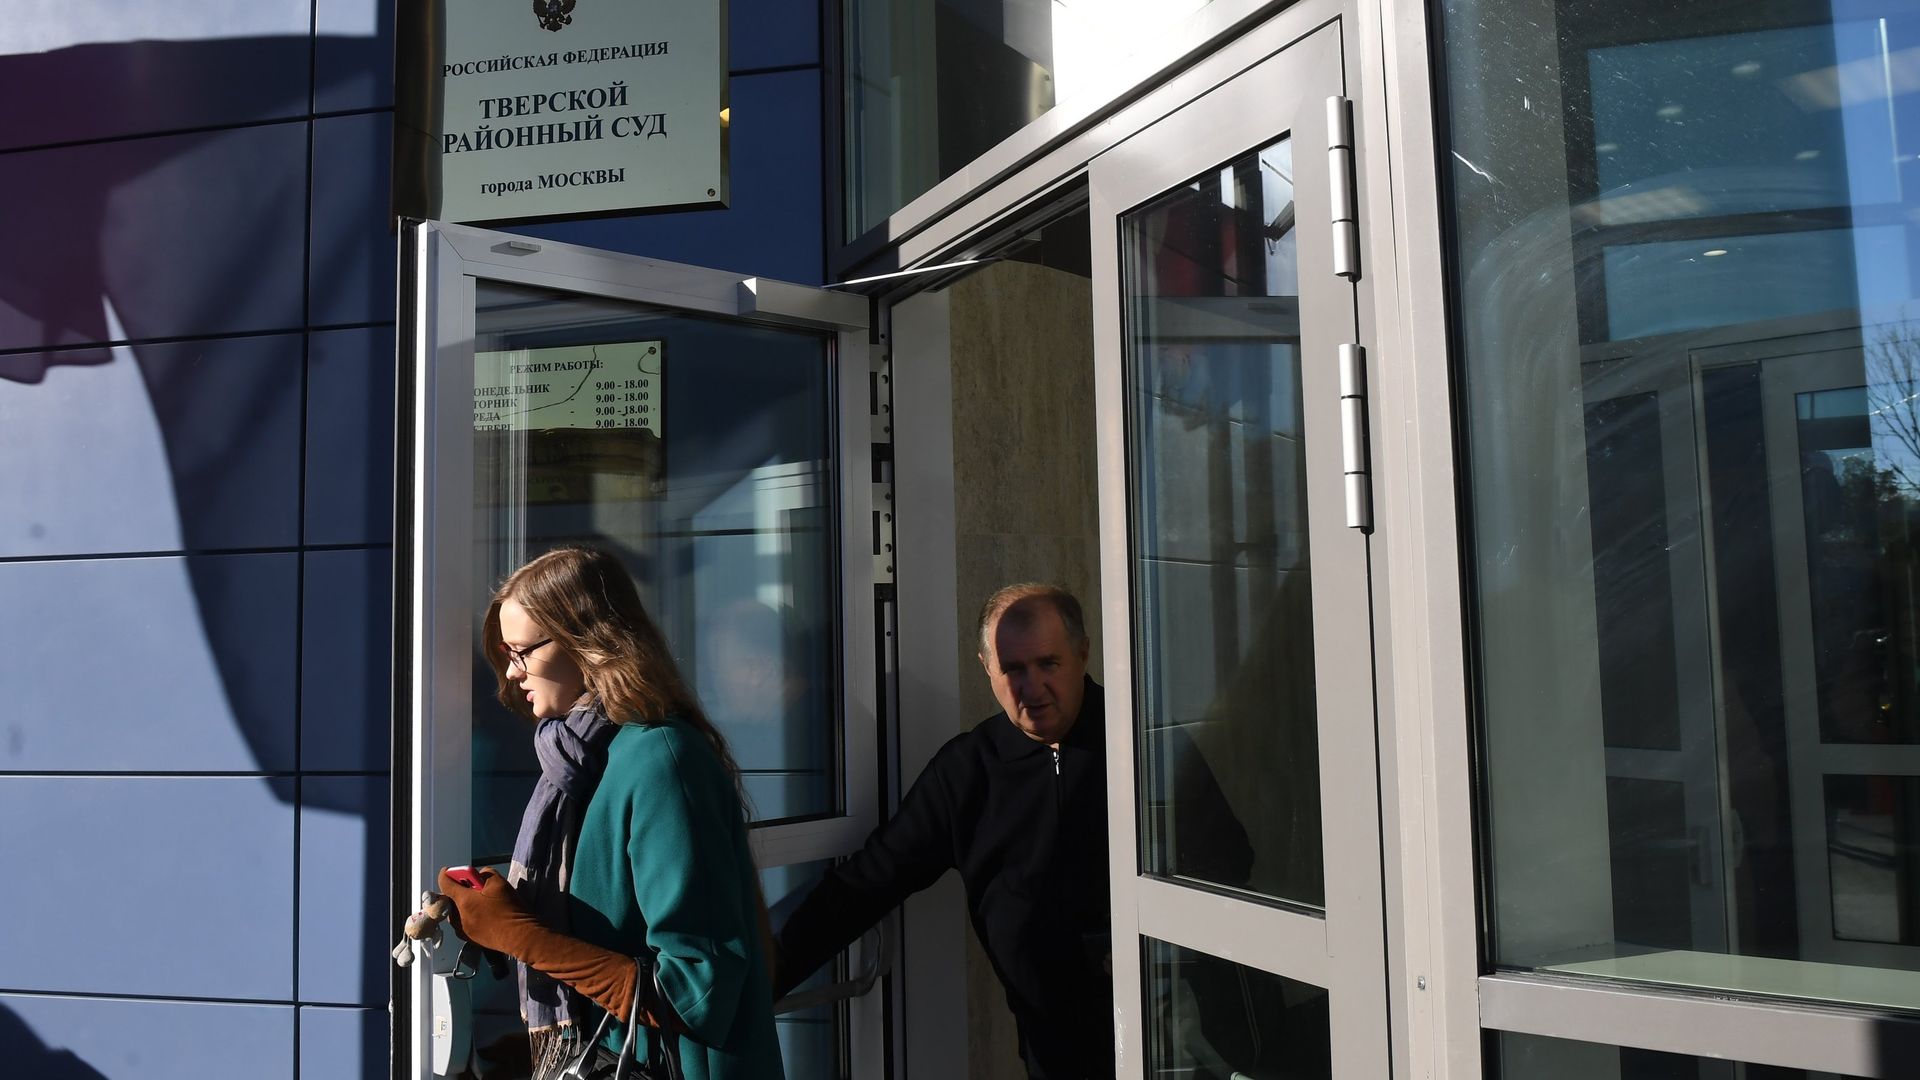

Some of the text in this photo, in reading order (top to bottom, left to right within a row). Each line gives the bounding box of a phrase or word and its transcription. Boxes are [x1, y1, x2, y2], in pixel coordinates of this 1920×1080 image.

[442, 41, 669, 77] РОССИЙСКАЯ ФЕДЕРАЦИЯ
[479, 81, 629, 119] ТВЕРСКОЙ
[442, 113, 667, 154] РАЙОННЫЙ СУД
[480, 167, 625, 197] города МОСКВЫ
[511, 360, 604, 374] РЕЖИМ РАБОТЫ:
[474, 384, 551, 397] ОНЕДЕЛЬНИК
[596, 381, 615, 390] 9.00
[624, 379, 649, 389] 18.00
[474, 399, 518, 409] ТОРНИК
[596, 394, 615, 403] 9.00
[624, 392, 649, 401] 18.00
[474, 412, 501, 423] РЕДА
[596, 406, 615, 415] 9.00
[624, 405, 649, 414] 18.00
[596, 419, 615, 428] 9.00
[624, 417, 649, 427] 18.00
